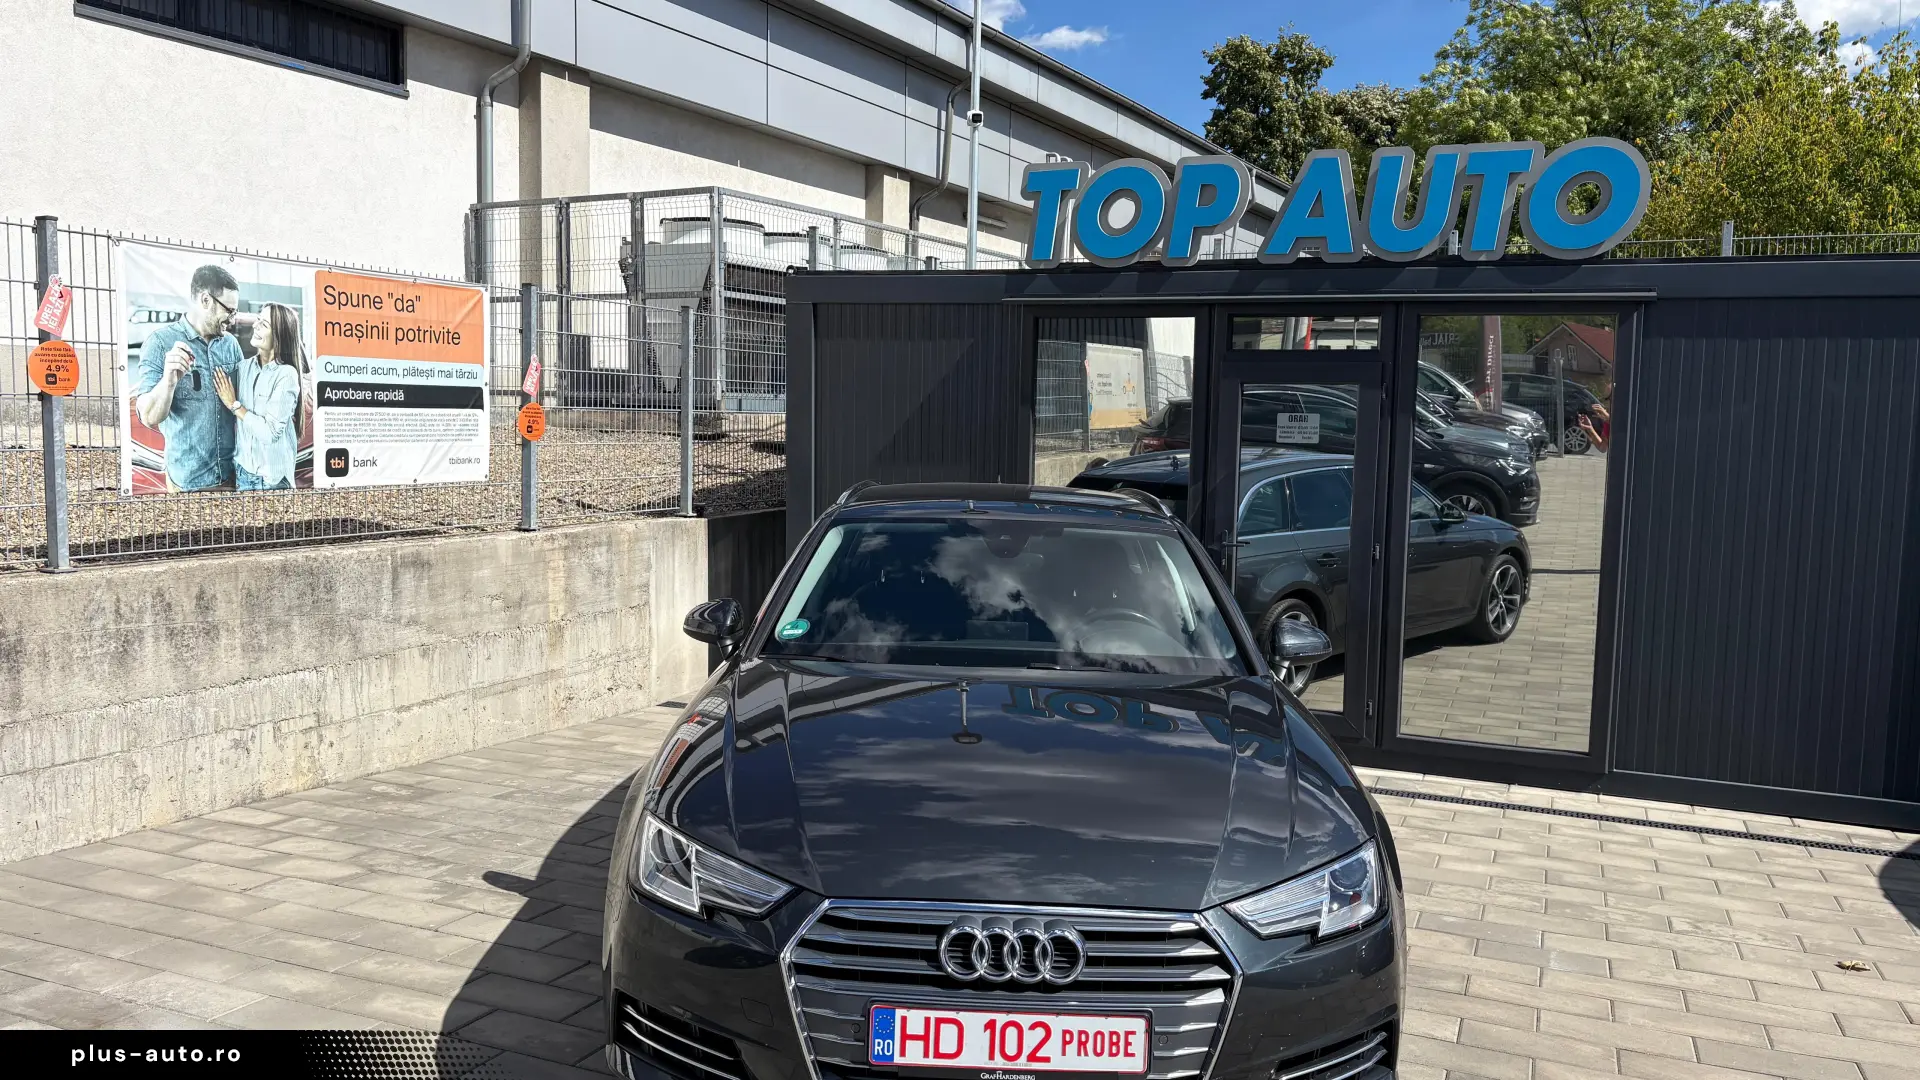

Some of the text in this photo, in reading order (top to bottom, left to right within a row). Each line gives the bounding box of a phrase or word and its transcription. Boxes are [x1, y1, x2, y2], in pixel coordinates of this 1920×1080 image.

[1024, 139, 1649, 266] TOP AUTO
[323, 284, 421, 313] Spune "da"
[39, 304, 53, 325] VREI
[324, 320, 461, 346] mașinii potrivite
[46, 364, 69, 373] 4.9%
[324, 361, 478, 380] Cumperi acum, plătești mai târziu
[324, 386, 404, 403] Aprobare rapidă
[329, 456, 481, 469] tbi bank tbibank.ro
[874, 1015, 1137, 1063] RO HD 102 PROBE
